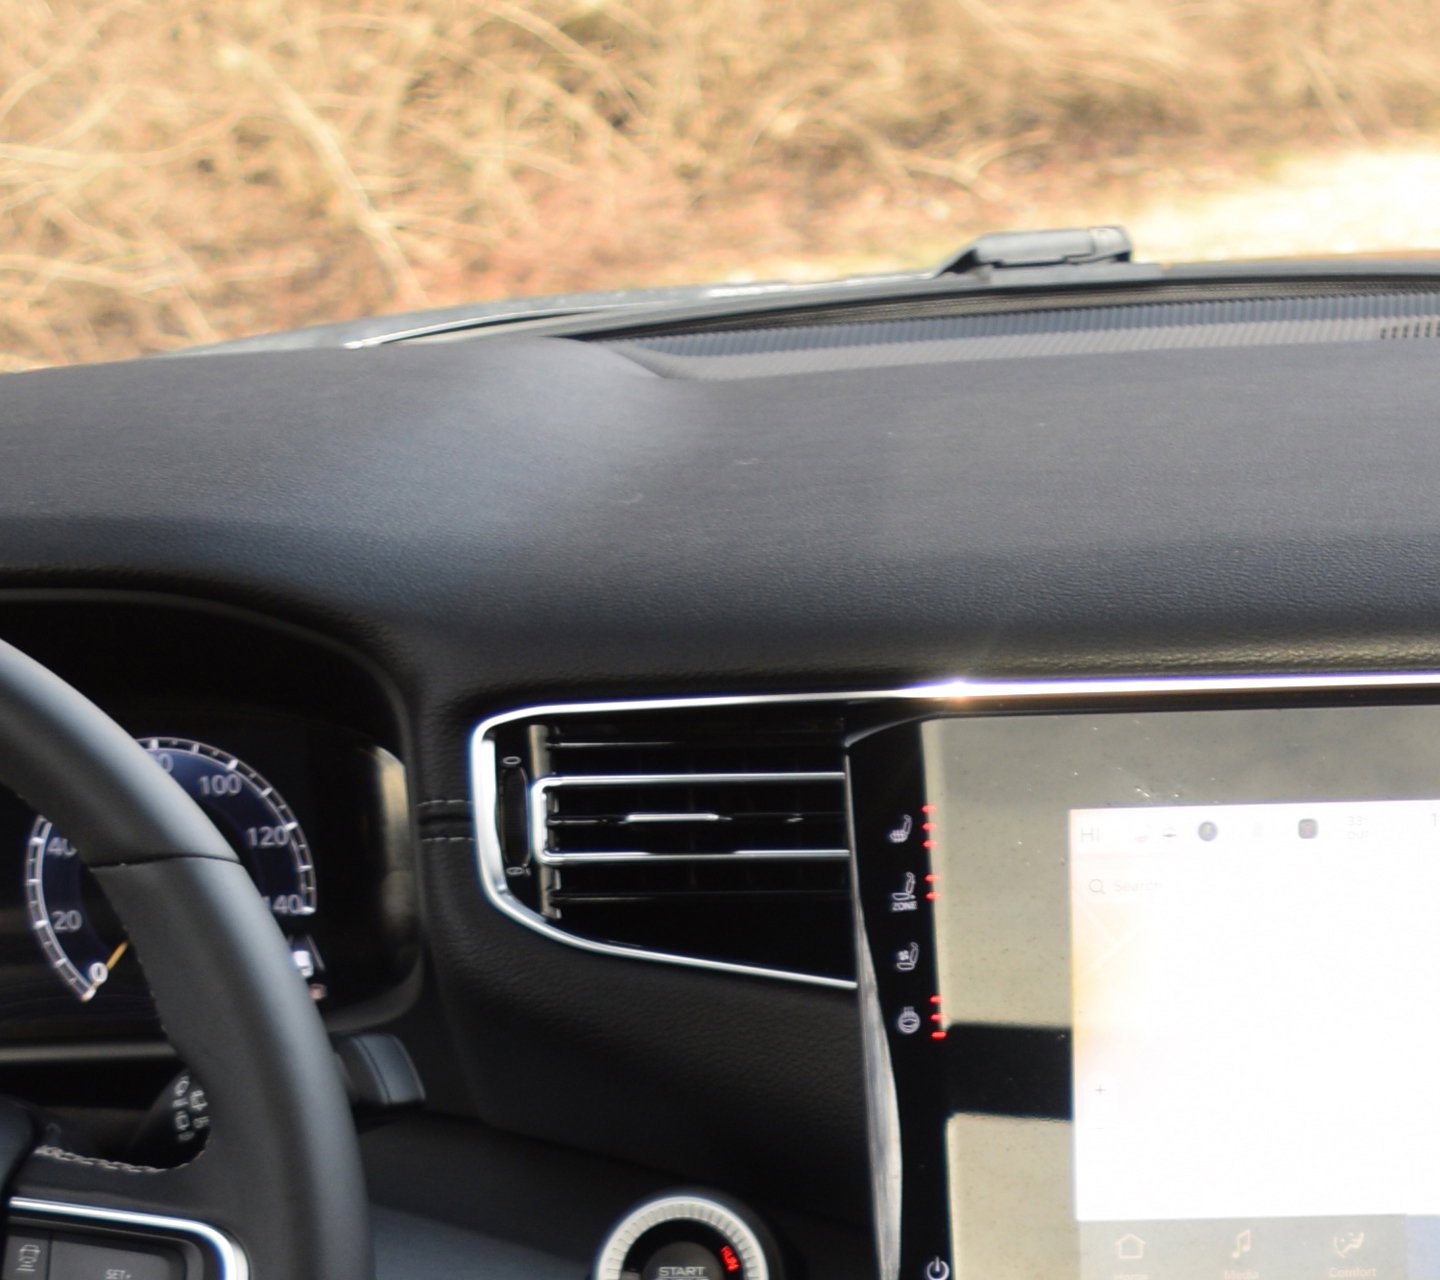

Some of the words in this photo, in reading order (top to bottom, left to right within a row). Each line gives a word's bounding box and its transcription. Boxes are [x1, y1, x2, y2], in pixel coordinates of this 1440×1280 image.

[199, 773, 242, 795] 100
[247, 825, 290, 847] 120
[1080, 826, 1100, 843] HI
[892, 901, 918, 912] ZONE
[52, 910, 82, 931] 20
[88, 961, 109, 984] 0
[659, 1266, 705, 1277] START
[1223, 1270, 1259, 1280] Media
[1329, 1267, 1377, 1279] Comfort
